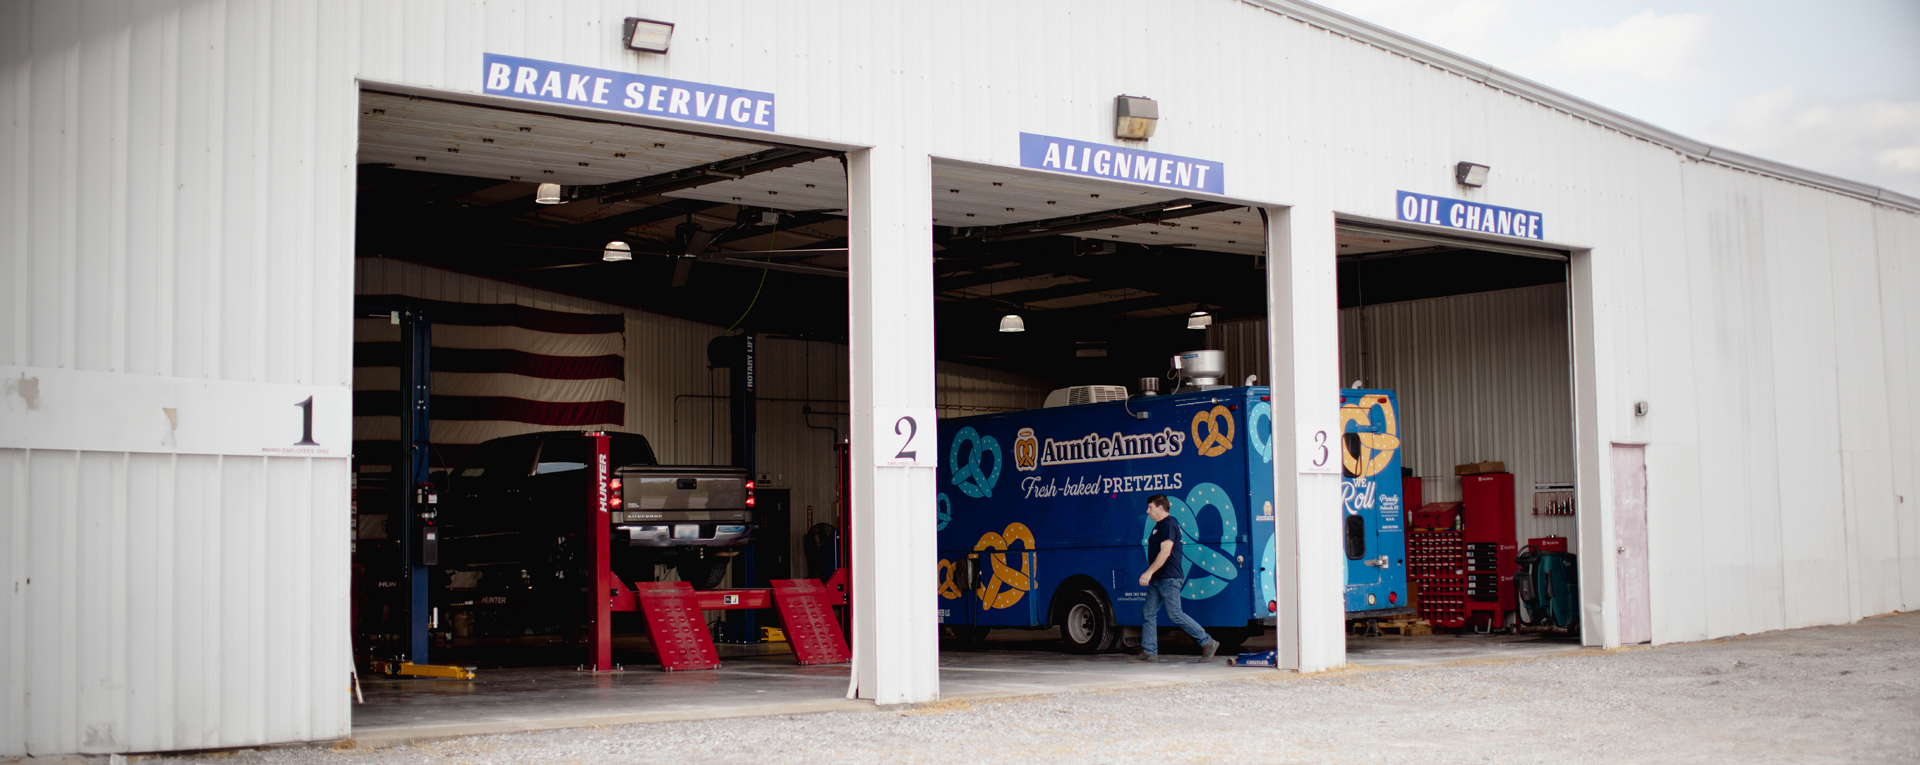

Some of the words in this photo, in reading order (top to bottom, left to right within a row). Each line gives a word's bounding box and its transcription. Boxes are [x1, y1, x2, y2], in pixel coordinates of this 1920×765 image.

[486, 62, 613, 105] BRAKE
[623, 82, 773, 126] SERVICE
[1042, 142, 1210, 189] ALIGNMENT
[1402, 195, 1441, 225] OIL
[1450, 203, 1540, 239] CHANGE
[293, 395, 320, 446] 1
[894, 415, 917, 462] 2
[1042, 429, 1183, 463] AuntieAnne's
[1312, 430, 1329, 467] 3
[599, 453, 608, 513] HUNTER
[1021, 474, 1102, 499] Fresh-baked
[1103, 472, 1183, 494] PRETZELS
[1340, 481, 1376, 515] Roll
[1352, 478, 1367, 488] WE
[481, 596, 507, 604] HUNTER
